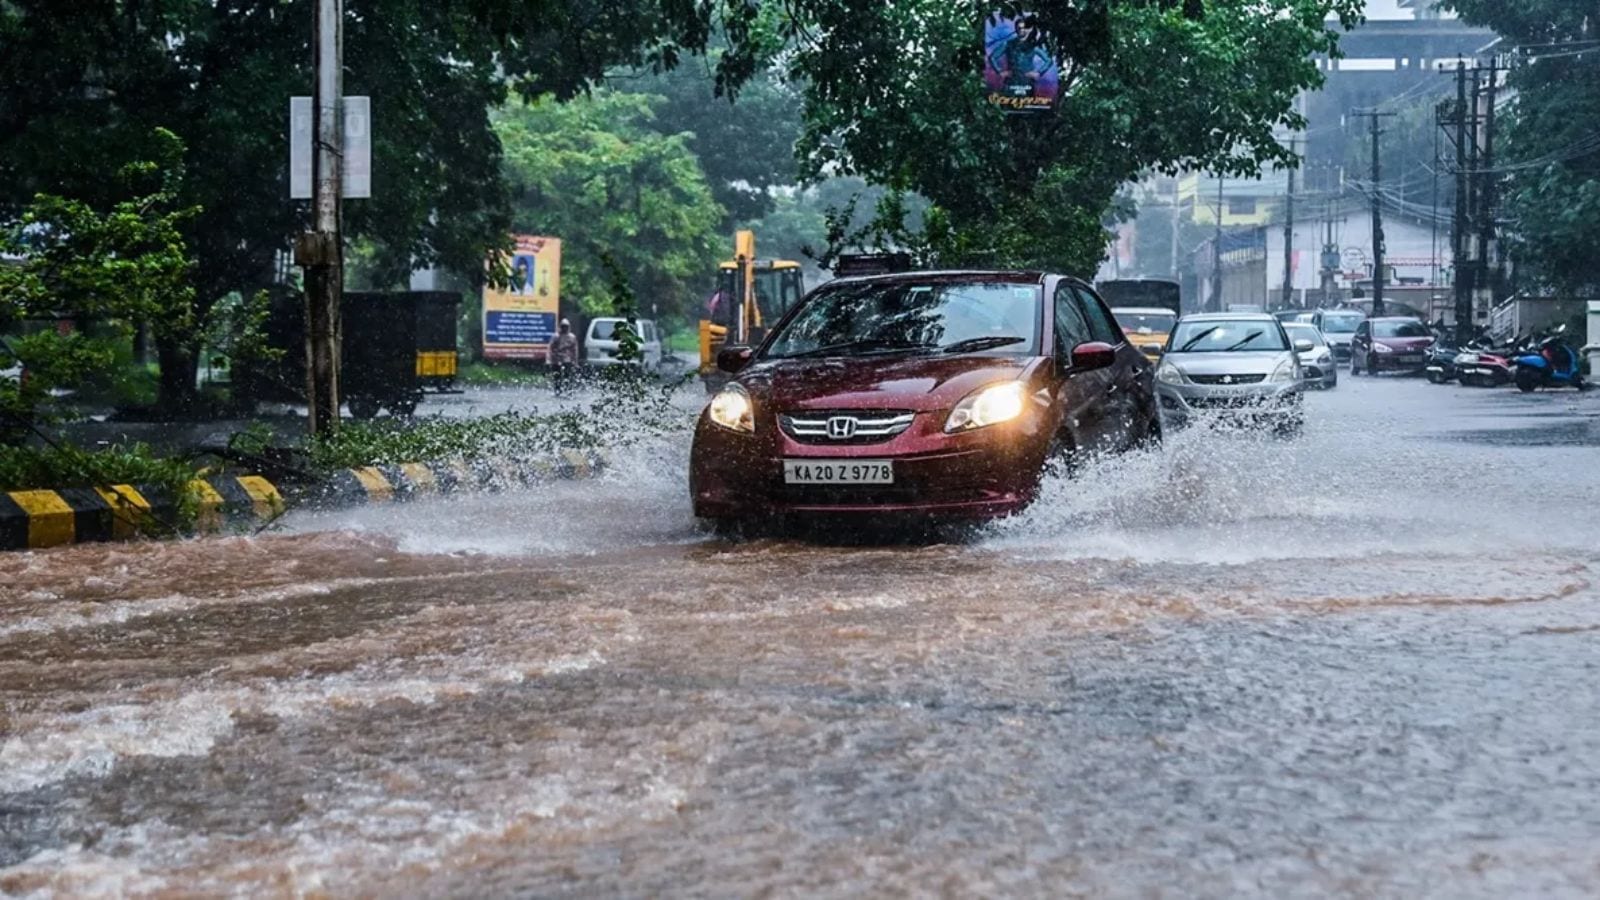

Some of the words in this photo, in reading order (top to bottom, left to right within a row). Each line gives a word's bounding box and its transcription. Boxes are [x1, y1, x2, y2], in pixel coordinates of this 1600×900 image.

[794, 465, 812, 480] KA
[815, 466, 833, 480] 20
[839, 466, 847, 480] Z
[852, 465, 890, 480] 9778
